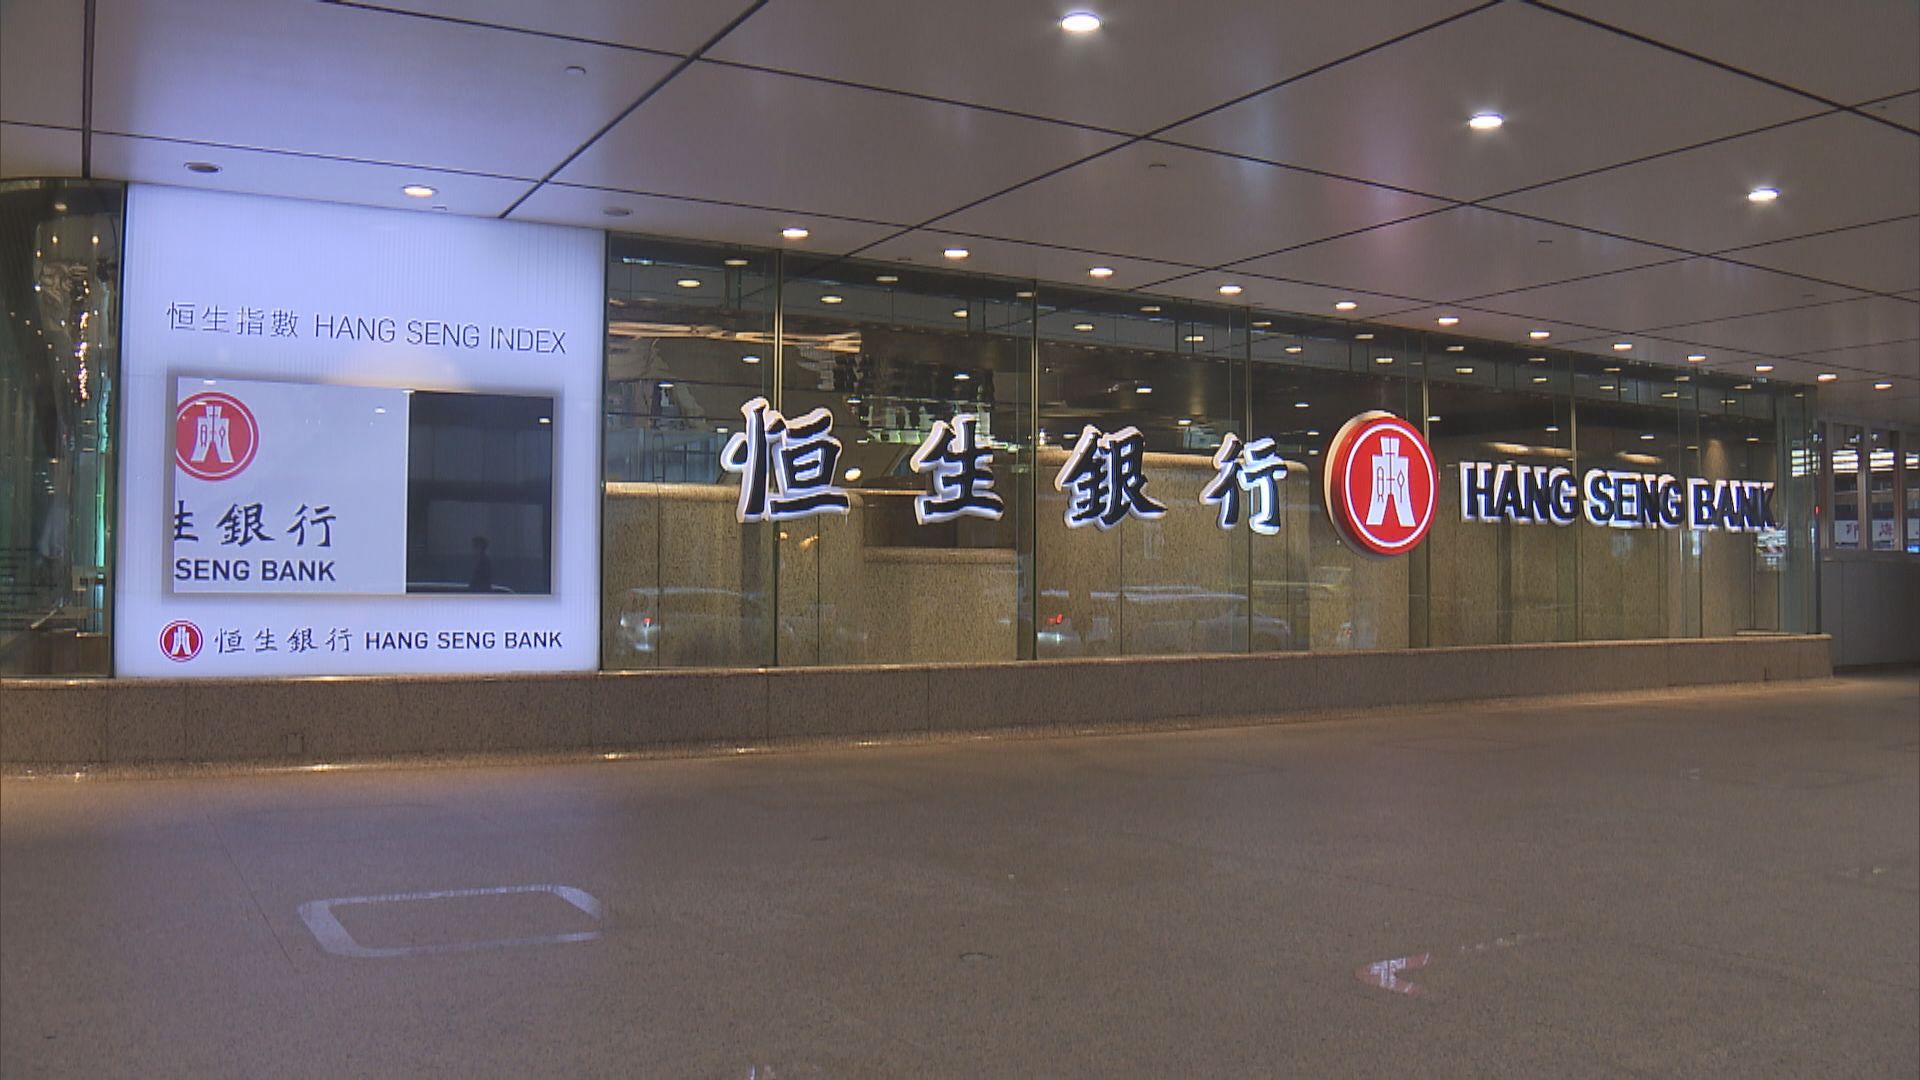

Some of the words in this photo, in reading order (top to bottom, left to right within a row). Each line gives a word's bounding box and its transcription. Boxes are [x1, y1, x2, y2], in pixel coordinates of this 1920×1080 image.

[166, 301, 299, 338] 恒生指數
[315, 314, 396, 343] HANG
[406, 320, 480, 349] SENG
[490, 326, 566, 355] INDEX
[720, 396, 1289, 535] 恒生銀行
[1459, 461, 1580, 525] HANG
[1584, 468, 1685, 529] SENG
[1687, 477, 1777, 533] BANK
[175, 558, 250, 581] SENG
[261, 559, 336, 582] BANK
[214, 628, 352, 654] 恒生銀行
[365, 631, 428, 650] HANG
[437, 631, 496, 650] SENG
[504, 631, 563, 649] BANK
